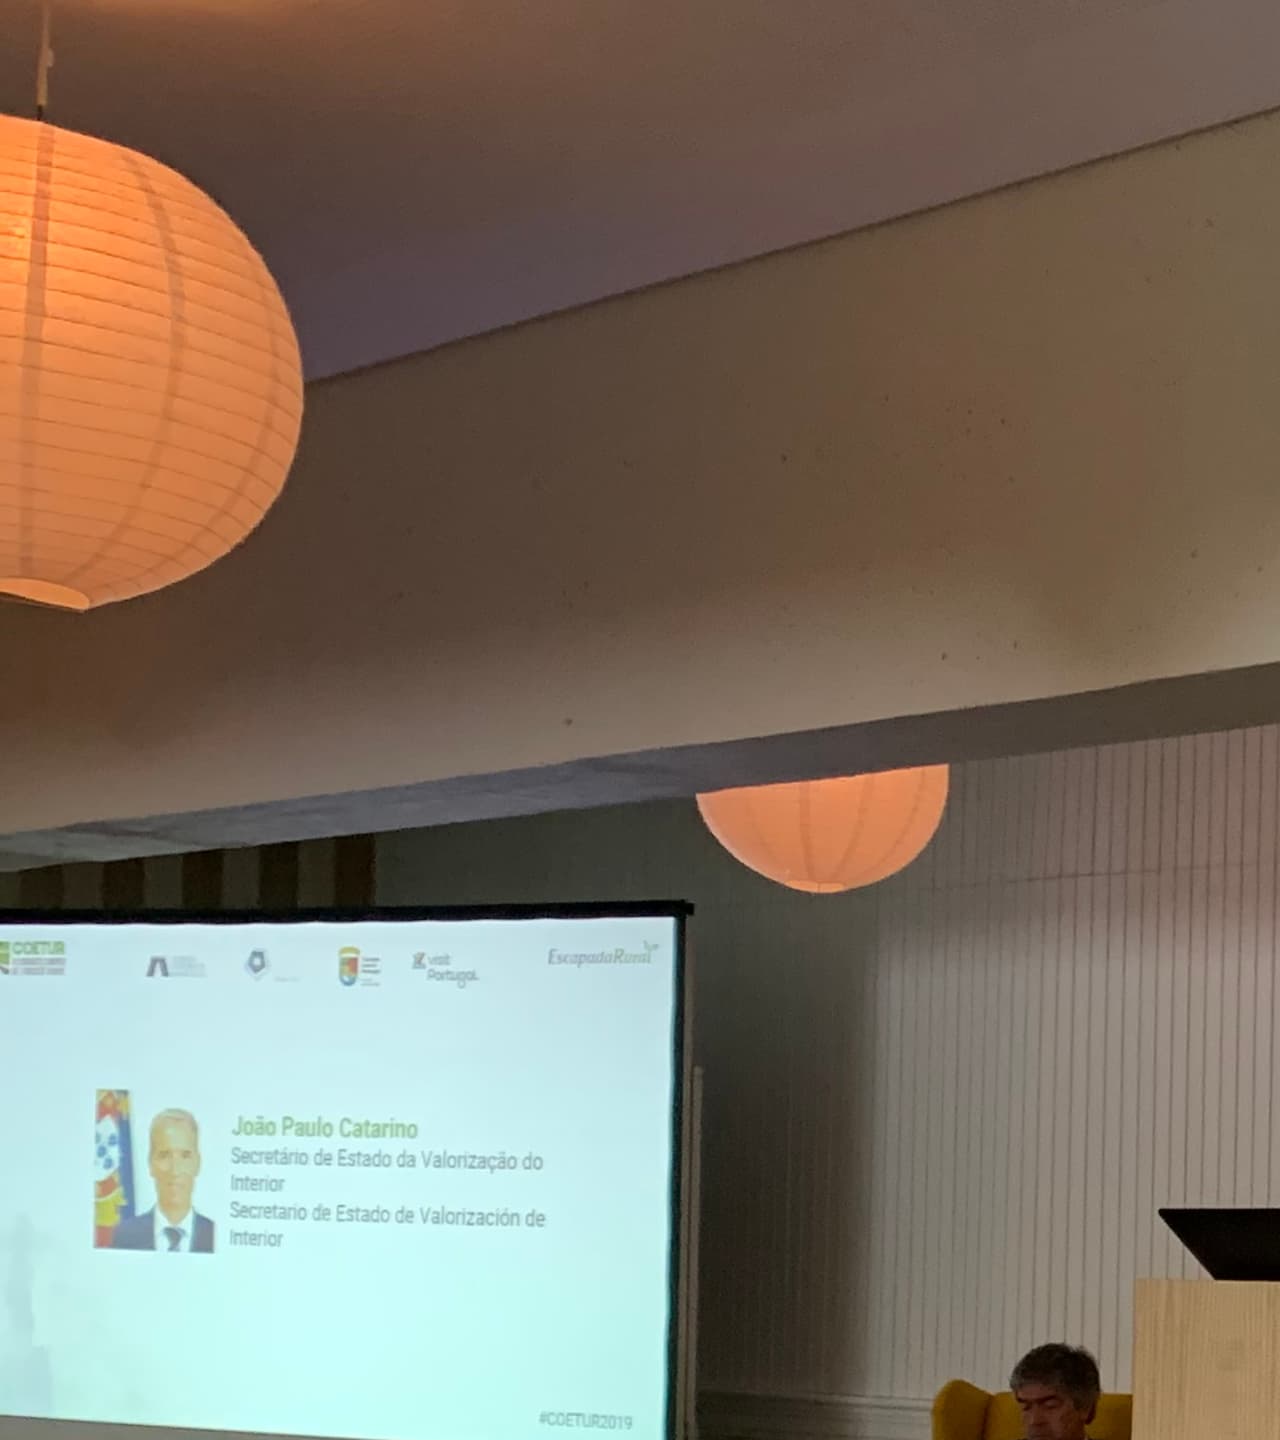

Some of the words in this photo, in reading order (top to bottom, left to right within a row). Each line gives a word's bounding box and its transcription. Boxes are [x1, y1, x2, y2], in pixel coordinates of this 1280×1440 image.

[547, 939, 659, 968] EscapadaRural
[232, 1116, 276, 1137] João
[281, 1116, 334, 1138] Paulo
[339, 1117, 418, 1139] Catarino
[231, 1147, 309, 1167] Secretário
[313, 1149, 332, 1166] de
[338, 1149, 392, 1168] Estado
[396, 1150, 416, 1168] da
[421, 1150, 517, 1174] Valorização
[522, 1151, 544, 1170] do
[231, 1175, 285, 1192] Interior
[230, 1201, 307, 1221] Secretario
[312, 1203, 331, 1221] de
[336, 1204, 390, 1223] Estado
[395, 1205, 415, 1224] de
[419, 1206, 521, 1227] Valorización
[525, 1209, 546, 1228] de
[229, 1230, 283, 1247] Interior
[539, 1411, 633, 1430] #COETUR2019
